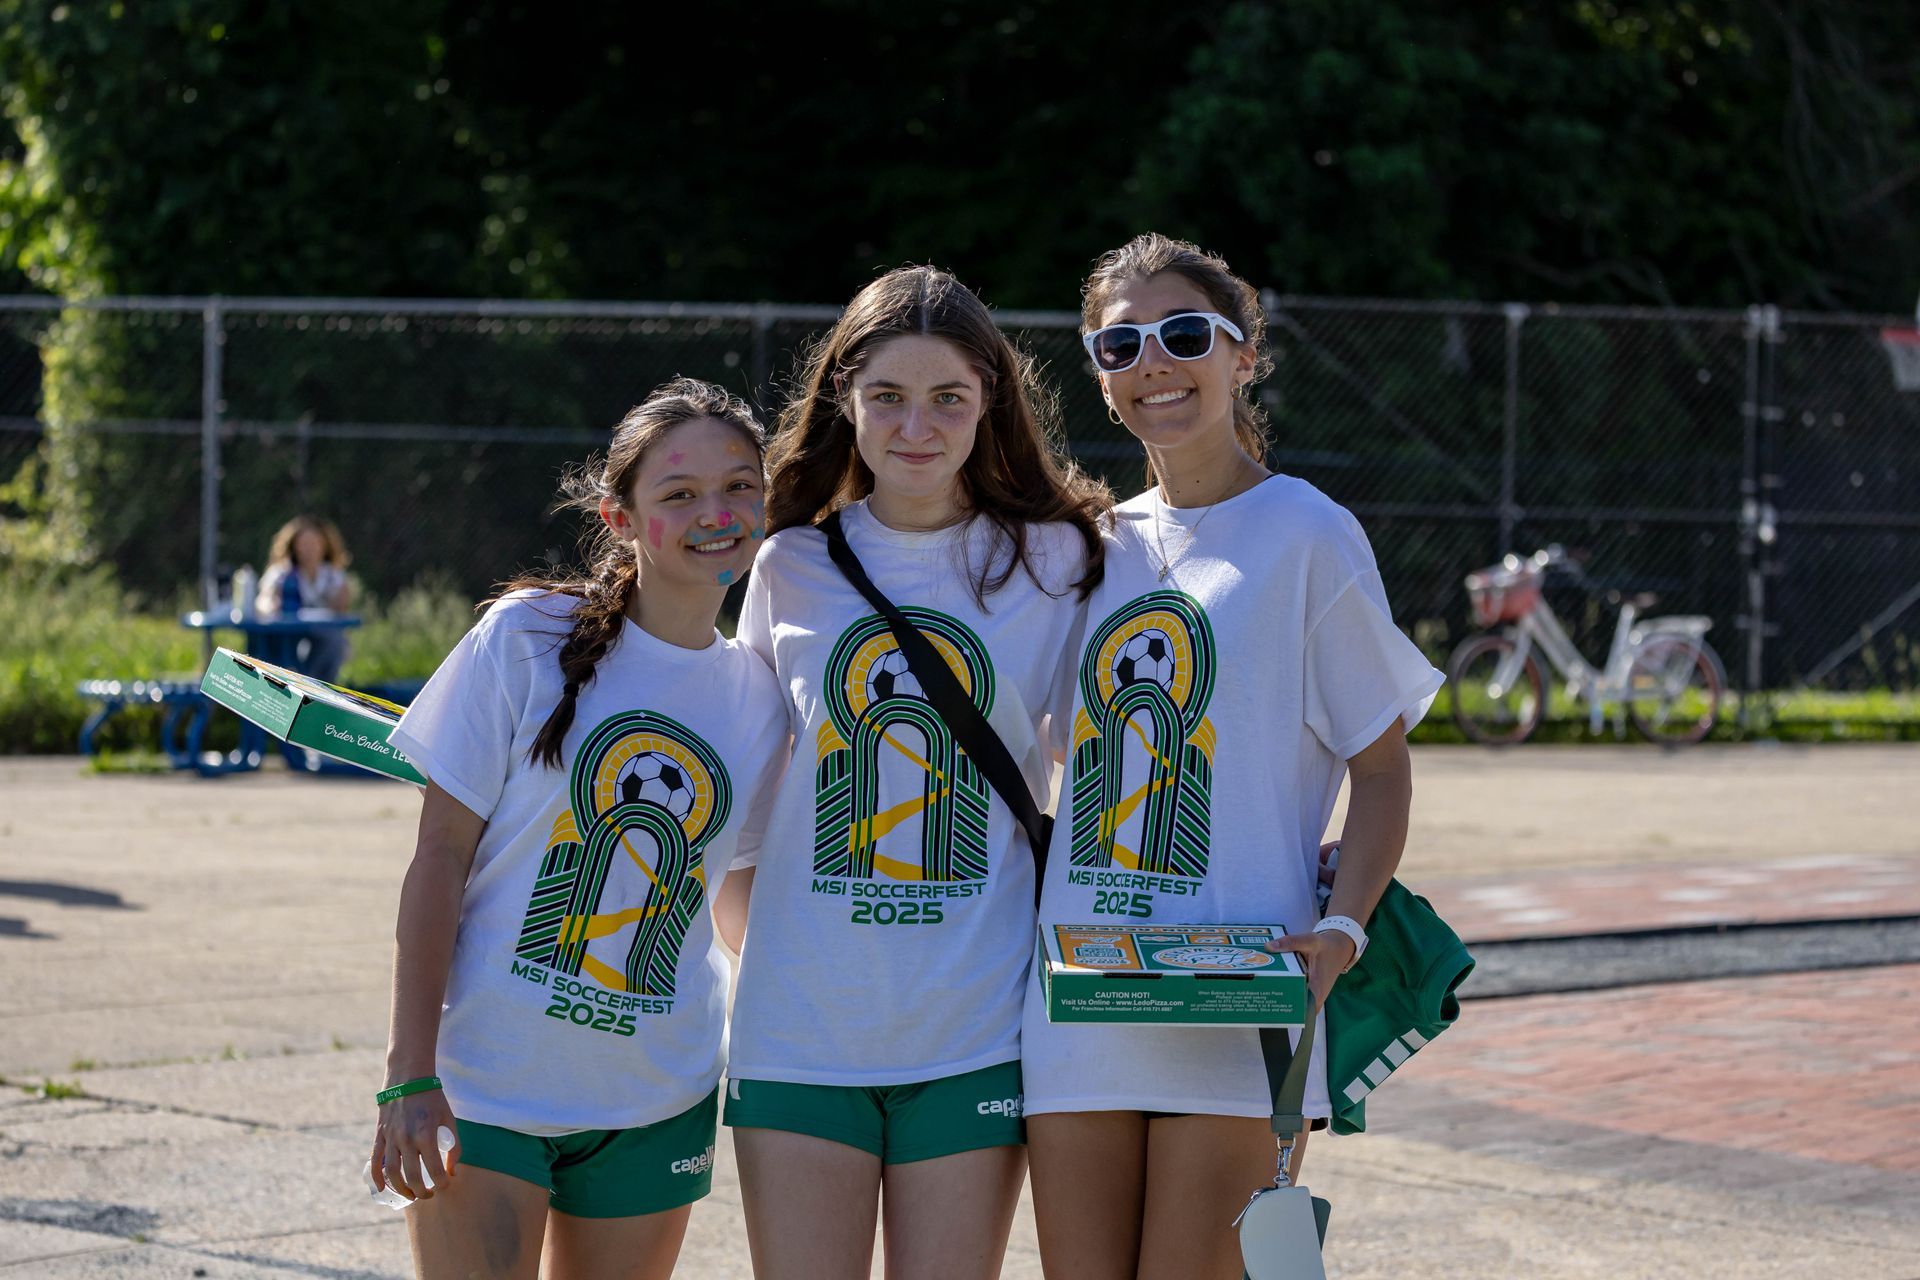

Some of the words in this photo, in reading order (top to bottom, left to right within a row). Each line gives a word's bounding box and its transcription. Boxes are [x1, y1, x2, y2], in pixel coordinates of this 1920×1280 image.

[324, 723, 355, 743] Order
[356, 734, 390, 755] Online
[811, 878, 847, 896] MSI
[851, 882, 987, 899] SOCCERFEST
[1068, 869, 1095, 886] MSI
[1096, 872, 1203, 897] SOCCERFEST
[851, 900, 944, 925] 2025
[1092, 890, 1154, 918] 2025
[510, 960, 549, 986] MSI
[552, 975, 675, 1015] SOCCERFEST
[1095, 991, 1130, 999] CAUTION
[1131, 991, 1150, 999] HOT!
[544, 994, 637, 1037] 2025
[1061, 998, 1076, 1006] Visit
[1077, 998, 1087, 1006] Us
[1088, 998, 1110, 1006] Online
[1116, 999, 1184, 1007] www.LedoPizza.com
[386, 1088, 402, 1099] May
